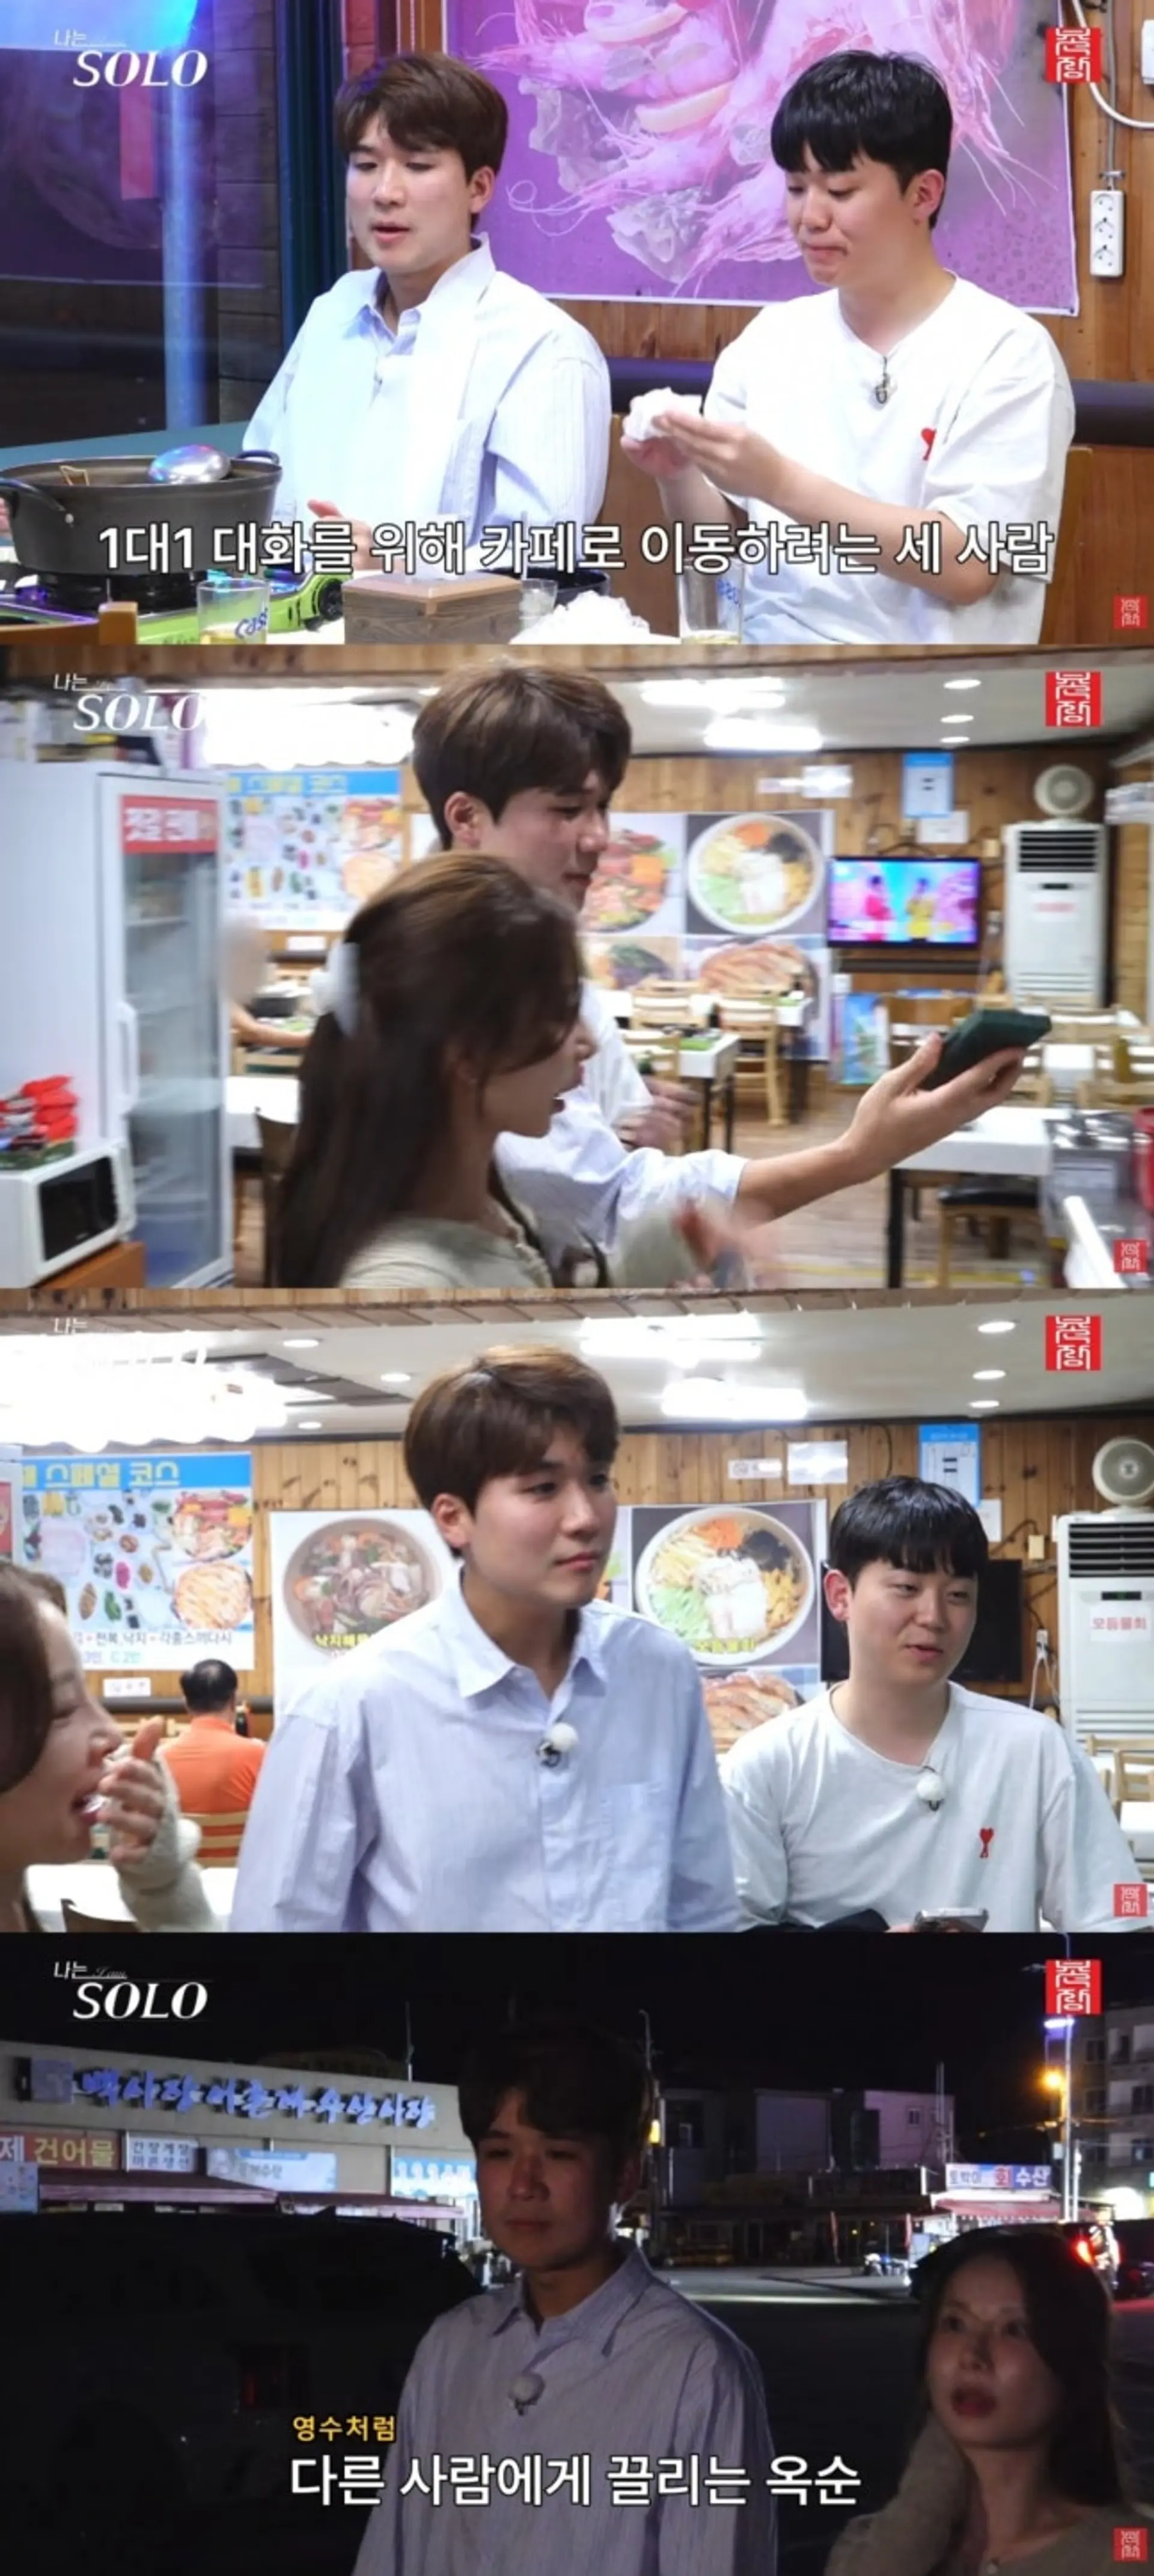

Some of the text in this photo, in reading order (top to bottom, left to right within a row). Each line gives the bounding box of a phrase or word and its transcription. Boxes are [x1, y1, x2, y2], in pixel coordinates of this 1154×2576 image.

[129, 1461, 179, 1487] 코스
[34, 2138, 115, 2167] 건어물
[995, 2167, 1011, 2186] 회
[1016, 2166, 1050, 2187] 수산
